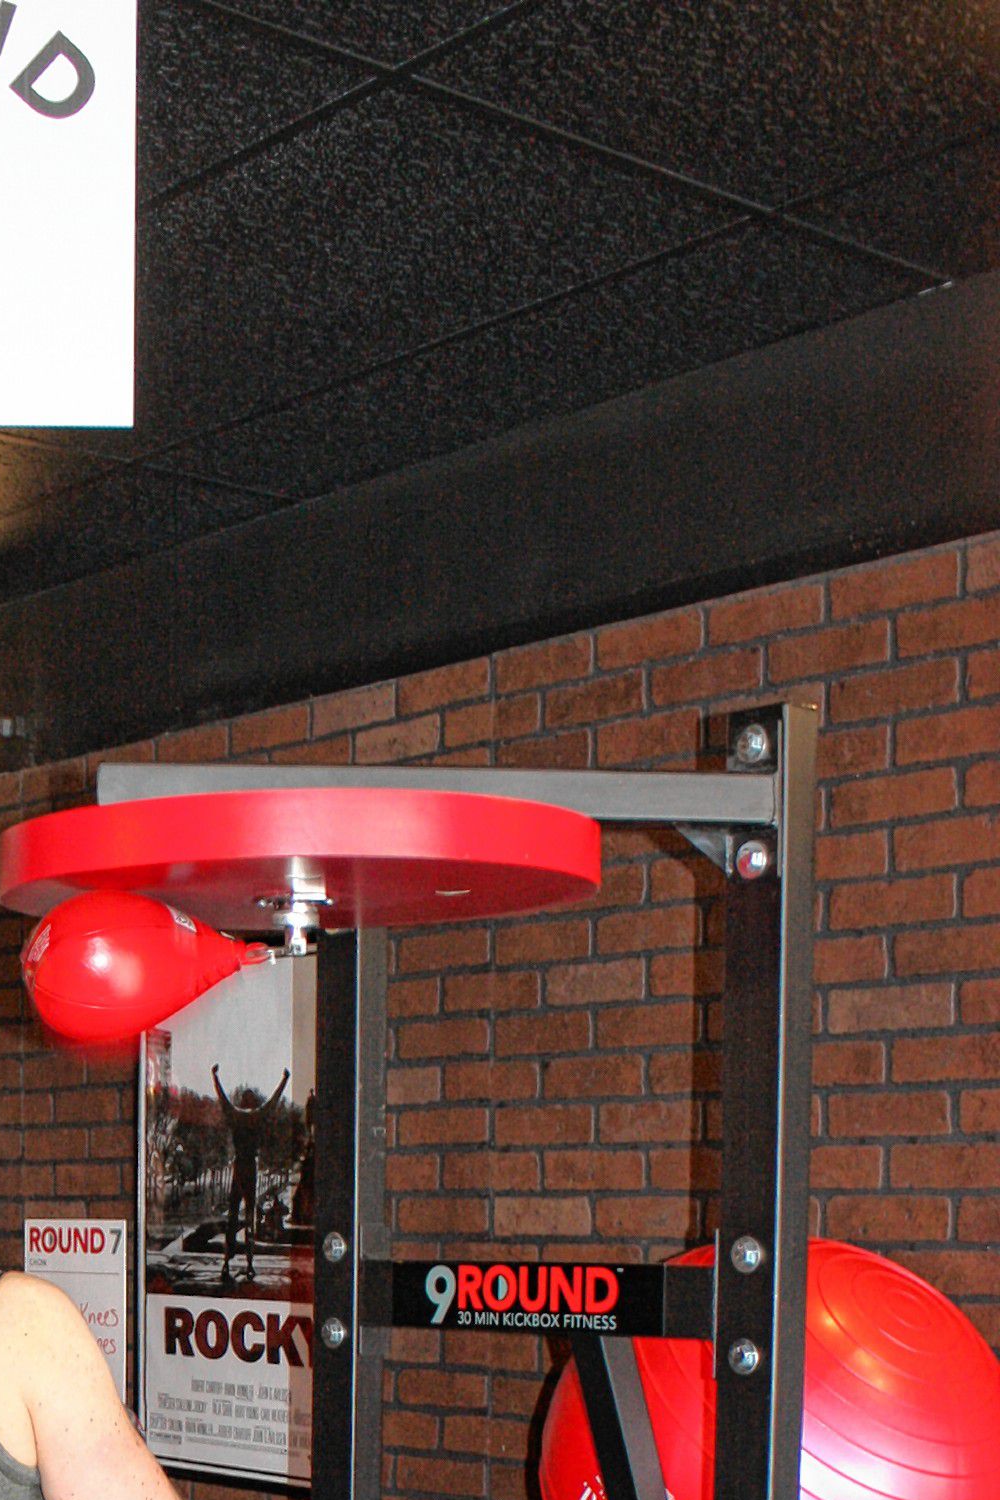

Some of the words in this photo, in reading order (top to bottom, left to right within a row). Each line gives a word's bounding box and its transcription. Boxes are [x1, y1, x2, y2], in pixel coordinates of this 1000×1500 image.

[29, 1226, 105, 1254] ROUND
[109, 1228, 122, 1255] 7
[425, 1264, 620, 1325] 9ROUND
[457, 1310, 472, 1326] 30
[474, 1312, 500, 1327] MIN
[502, 1312, 560, 1328] KICKBOX
[563, 1314, 617, 1331] FITNESS
